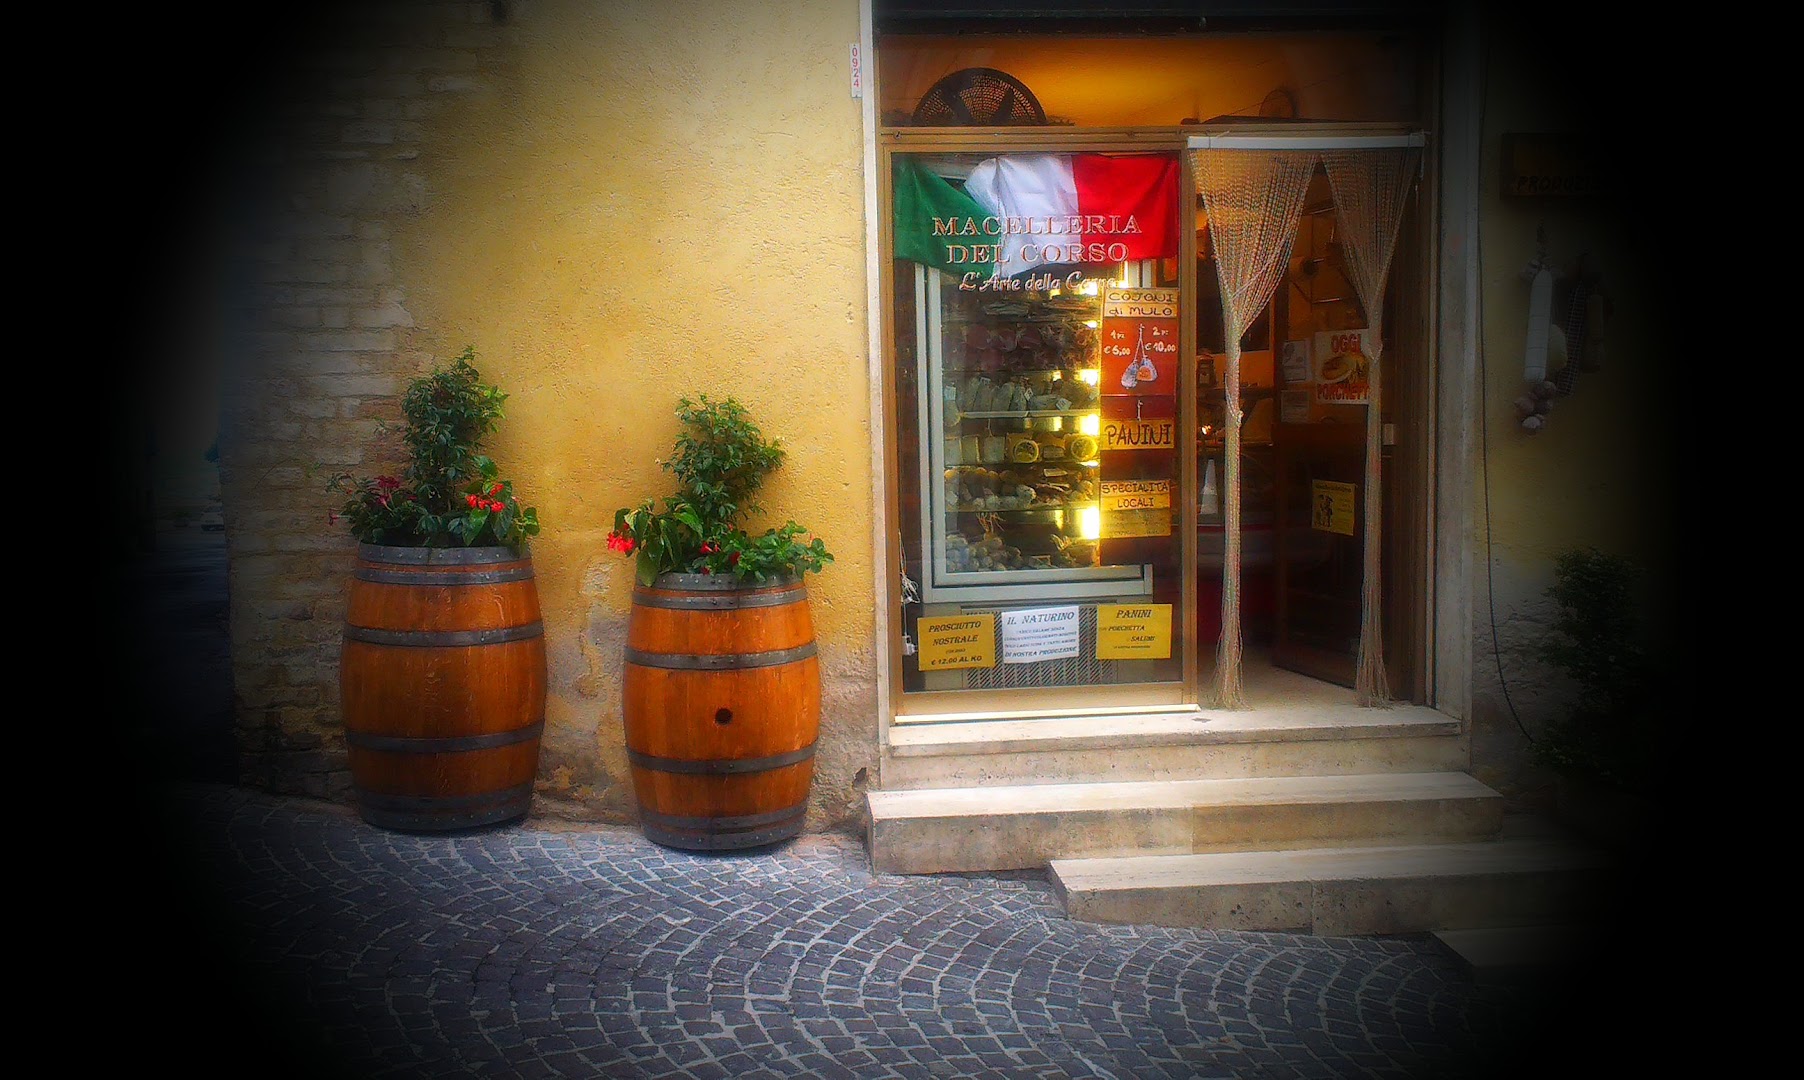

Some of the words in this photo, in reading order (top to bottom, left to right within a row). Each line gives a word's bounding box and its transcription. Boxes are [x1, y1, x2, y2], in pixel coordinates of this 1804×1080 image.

[851, 47, 860, 88] 0924
[931, 215, 1142, 236] MACELLERIA
[945, 244, 1010, 264] DEL
[1019, 243, 1129, 264] CORSO
[1024, 273, 1061, 291] della
[1109, 308, 1123, 316] di
[1129, 306, 1173, 316] MULO
[1152, 326, 1161, 336] 2
[1317, 382, 1370, 400] PORCHETT
[1104, 423, 1171, 445] PANINI
[1117, 497, 1154, 508] LOCALI
[1022, 612, 1074, 624] NATURINO
[1116, 609, 1152, 618] PANINI
[928, 621, 981, 632] PROSCIUTTO
[933, 635, 978, 646] NOSTRALE
[1012, 650, 1038, 658] NOSTRA
